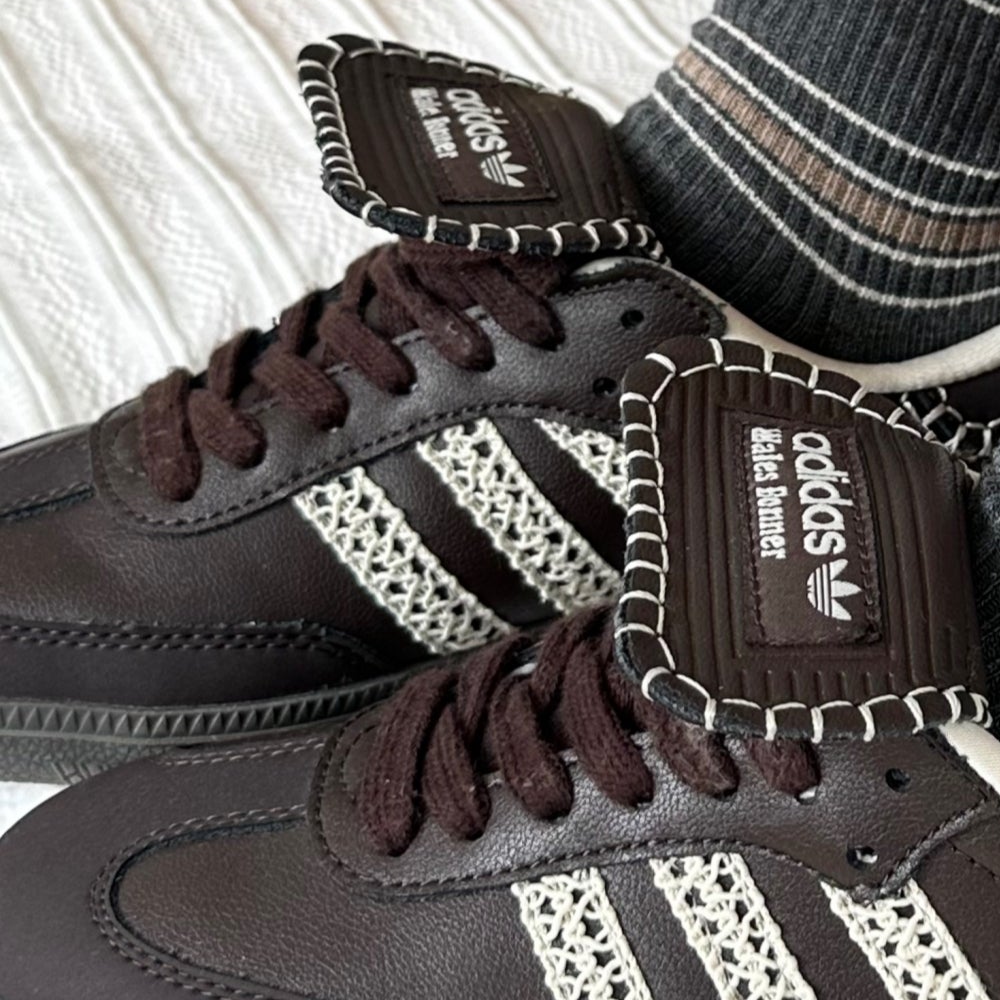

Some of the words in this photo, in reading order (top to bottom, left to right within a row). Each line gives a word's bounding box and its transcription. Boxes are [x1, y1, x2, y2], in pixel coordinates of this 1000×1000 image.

[446, 88, 509, 152] adidas
[751, 427, 784, 482] Wales
[756, 486, 788, 559] Bonner
[792, 432, 854, 555] adidas
